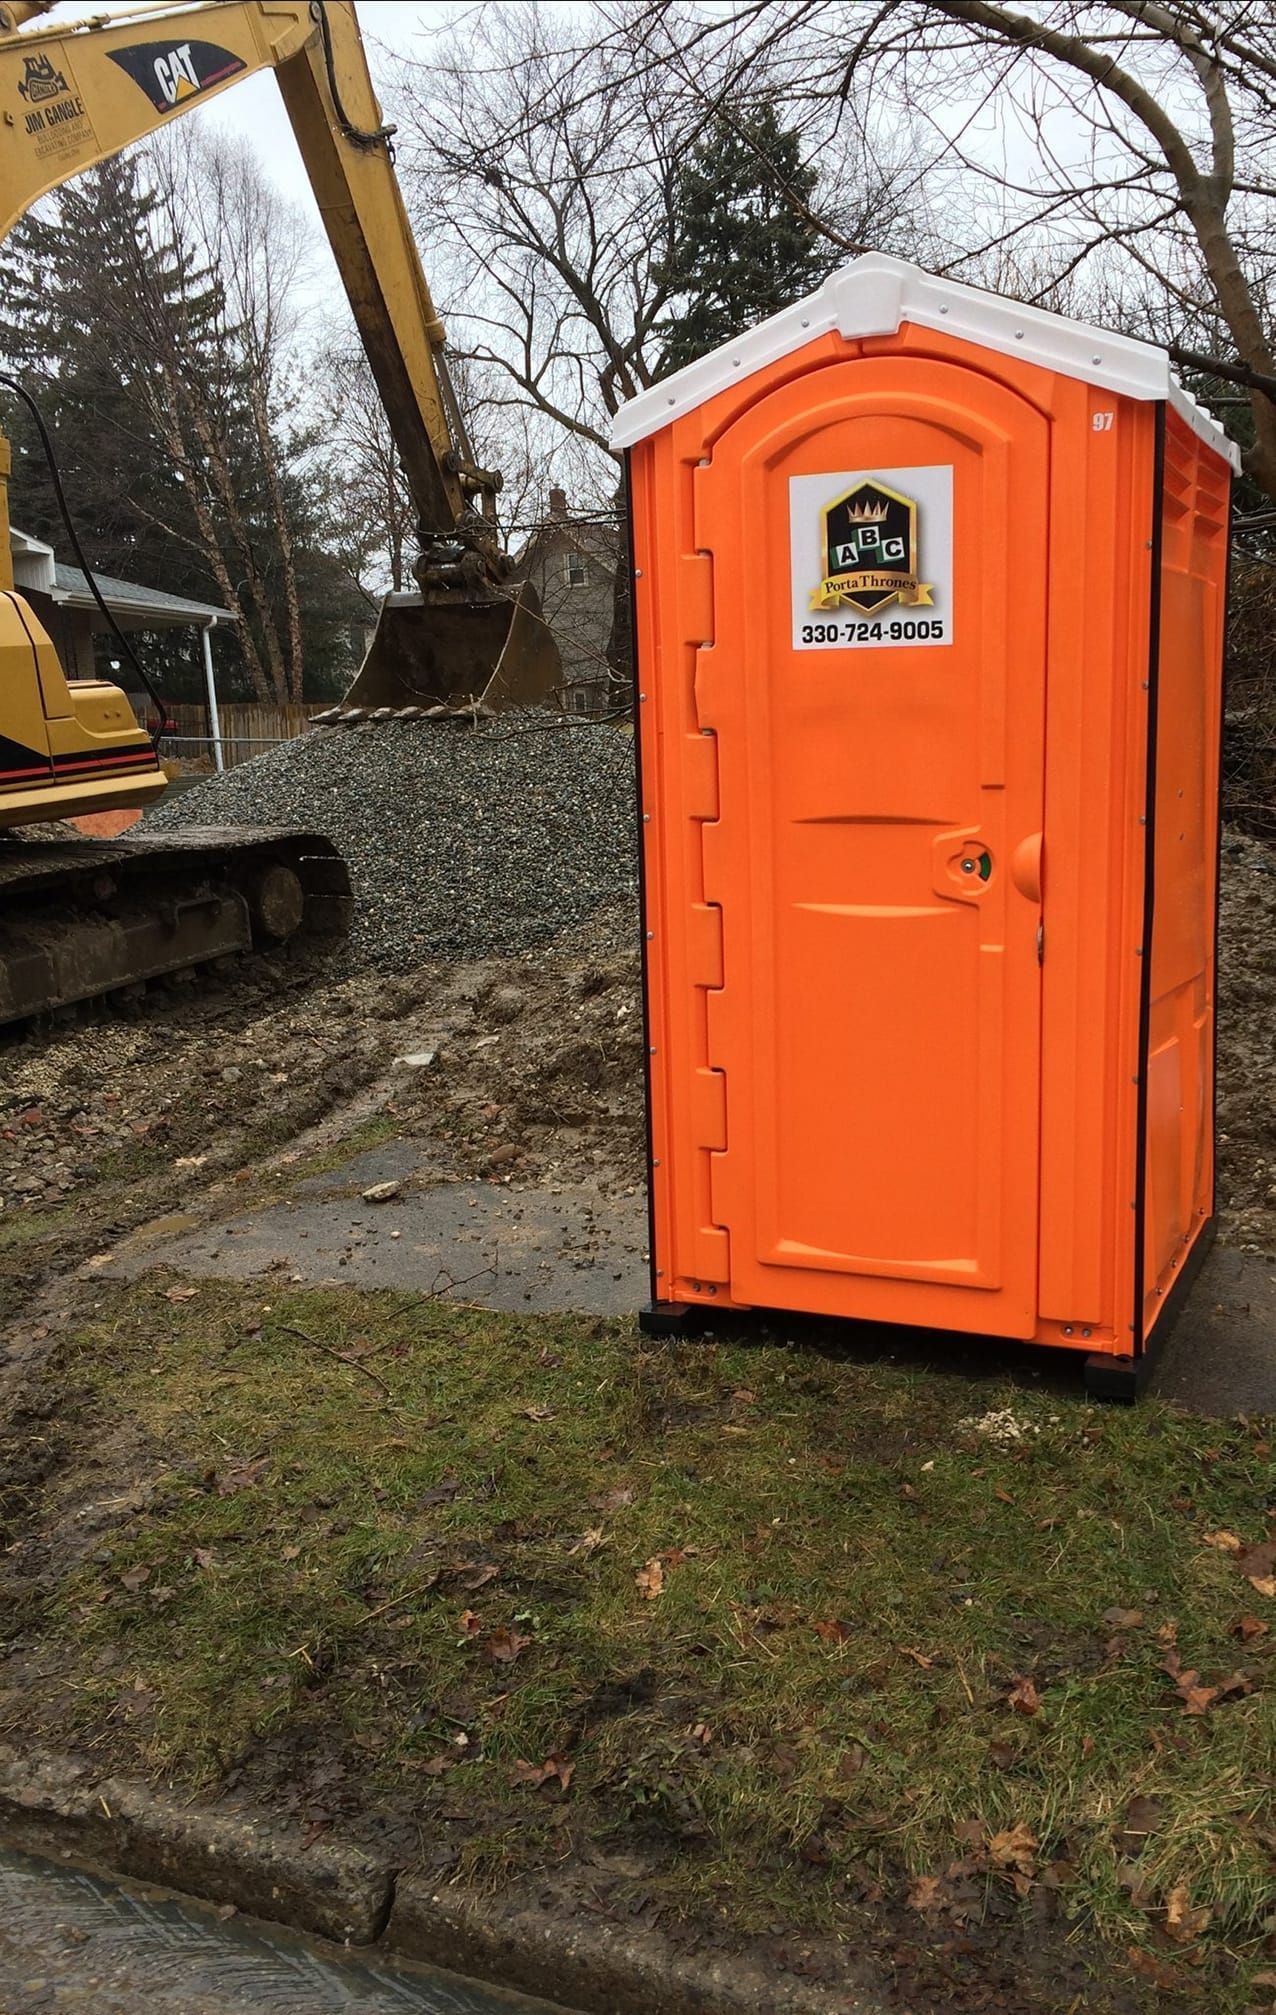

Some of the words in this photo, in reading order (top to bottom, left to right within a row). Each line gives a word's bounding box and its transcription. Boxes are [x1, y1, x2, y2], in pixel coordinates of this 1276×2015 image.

[153, 43, 201, 103] CAT
[24, 111, 46, 134] JIM
[44, 97, 85, 126] GANGLE
[1093, 412, 1114, 432] 97
[802, 620, 944, 643] 330-724-9005
